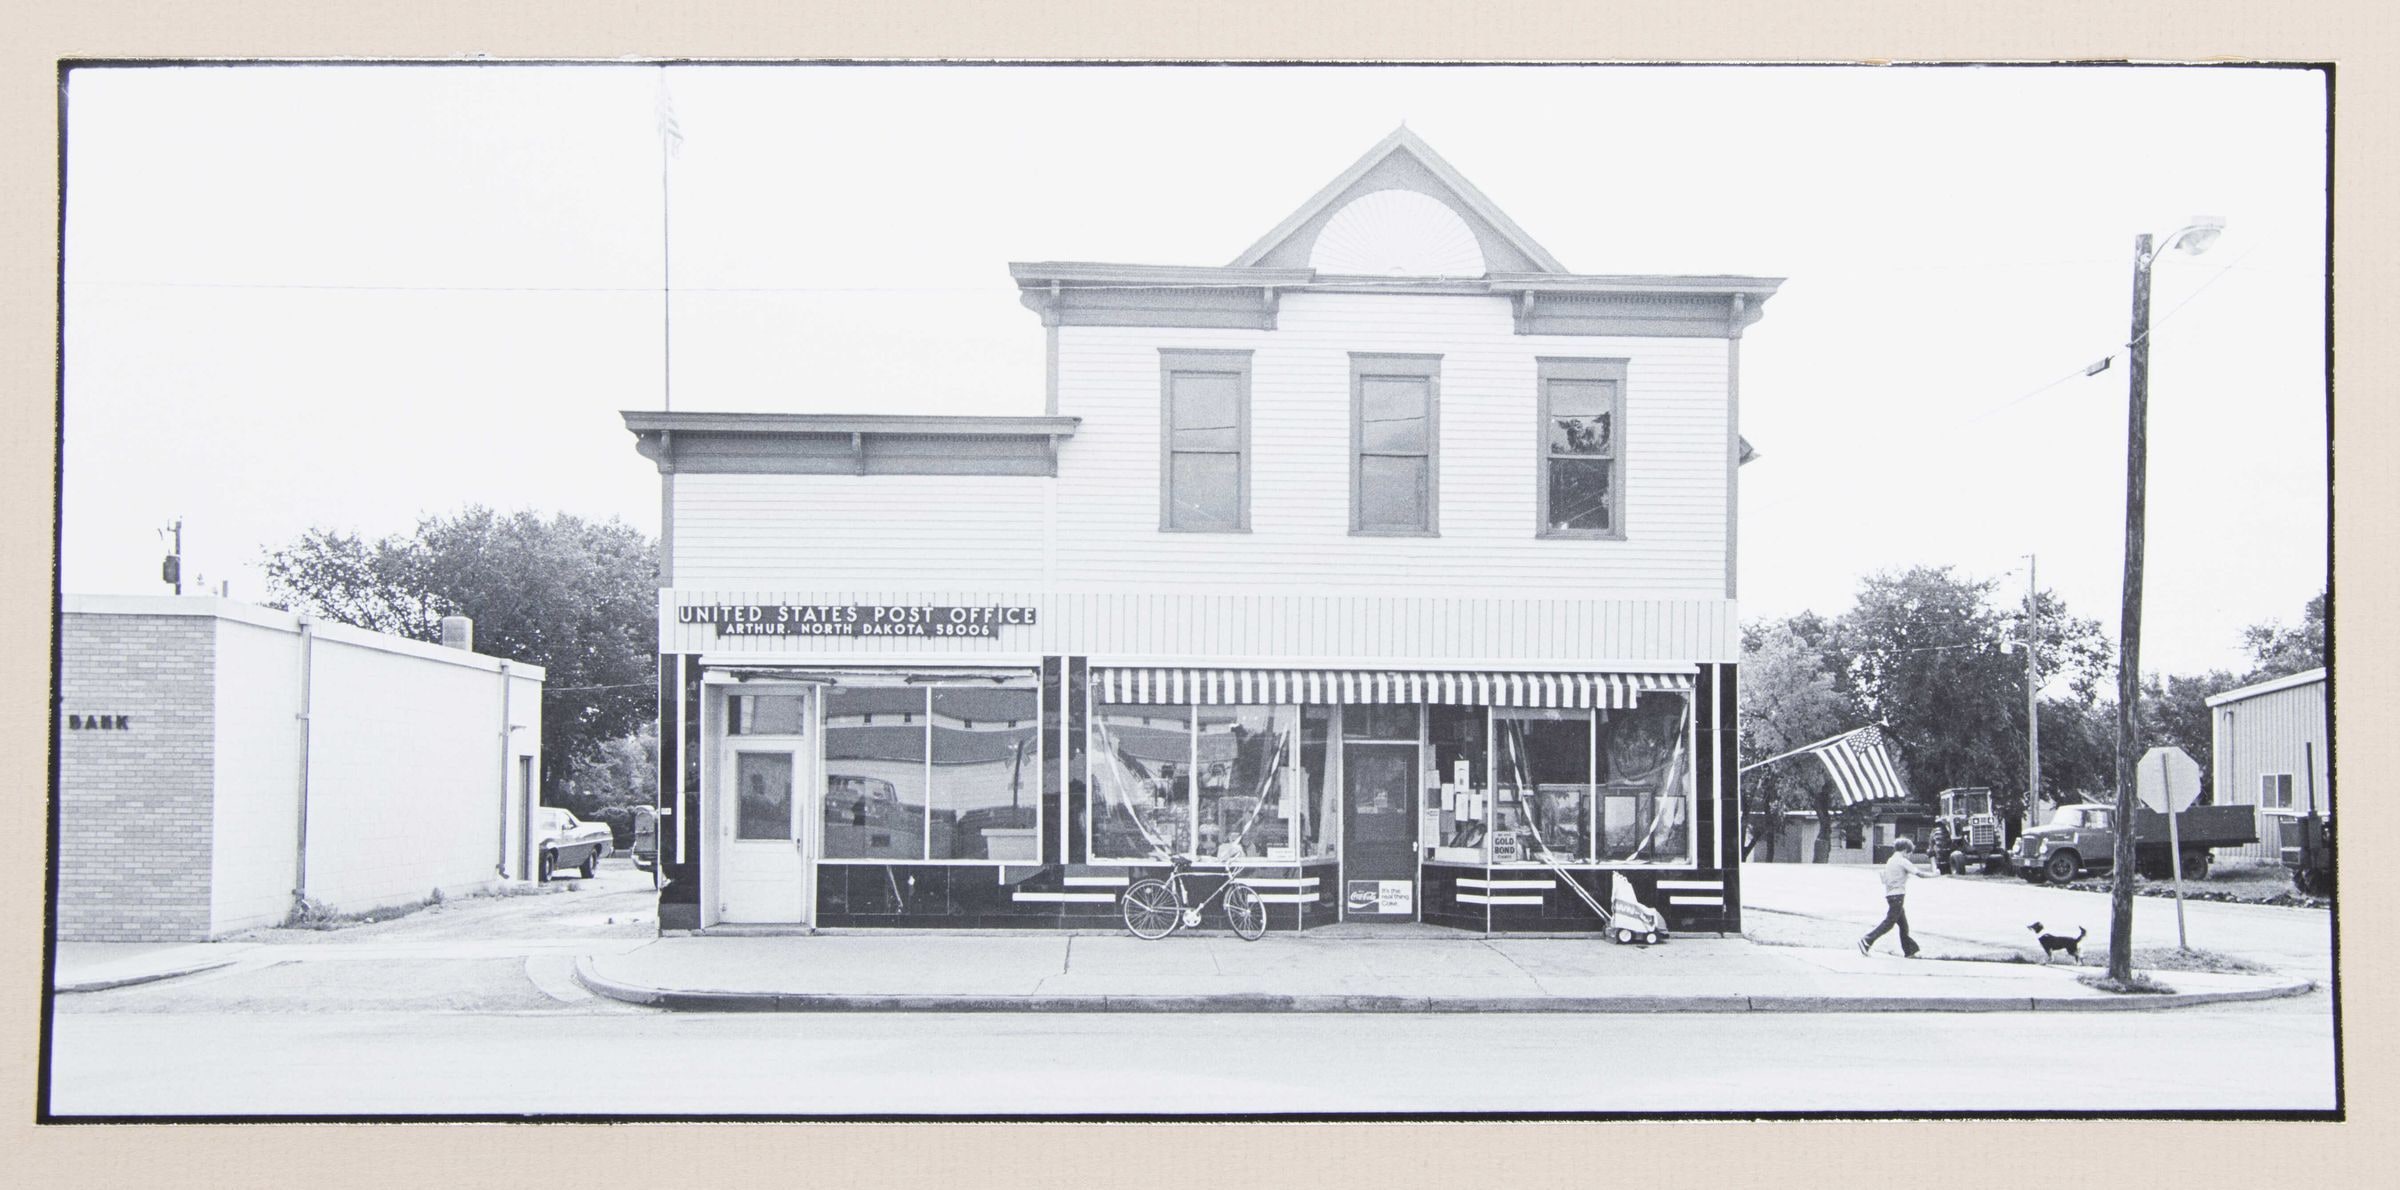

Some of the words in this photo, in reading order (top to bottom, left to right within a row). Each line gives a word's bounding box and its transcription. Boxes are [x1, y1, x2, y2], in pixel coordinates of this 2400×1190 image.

[681, 607, 762, 623] UNITED
[778, 607, 857, 623] STATES
[874, 607, 934, 624] POST
[950, 608, 1034, 624] OFFICE
[801, 623, 853, 635] NORTH
[863, 624, 925, 636] DAKOTA
[936, 624, 990, 636] 58006
[69, 714, 129, 731] BANK
[1495, 837, 1514, 845] GOLD
[1494, 846, 1515, 854] BOND
